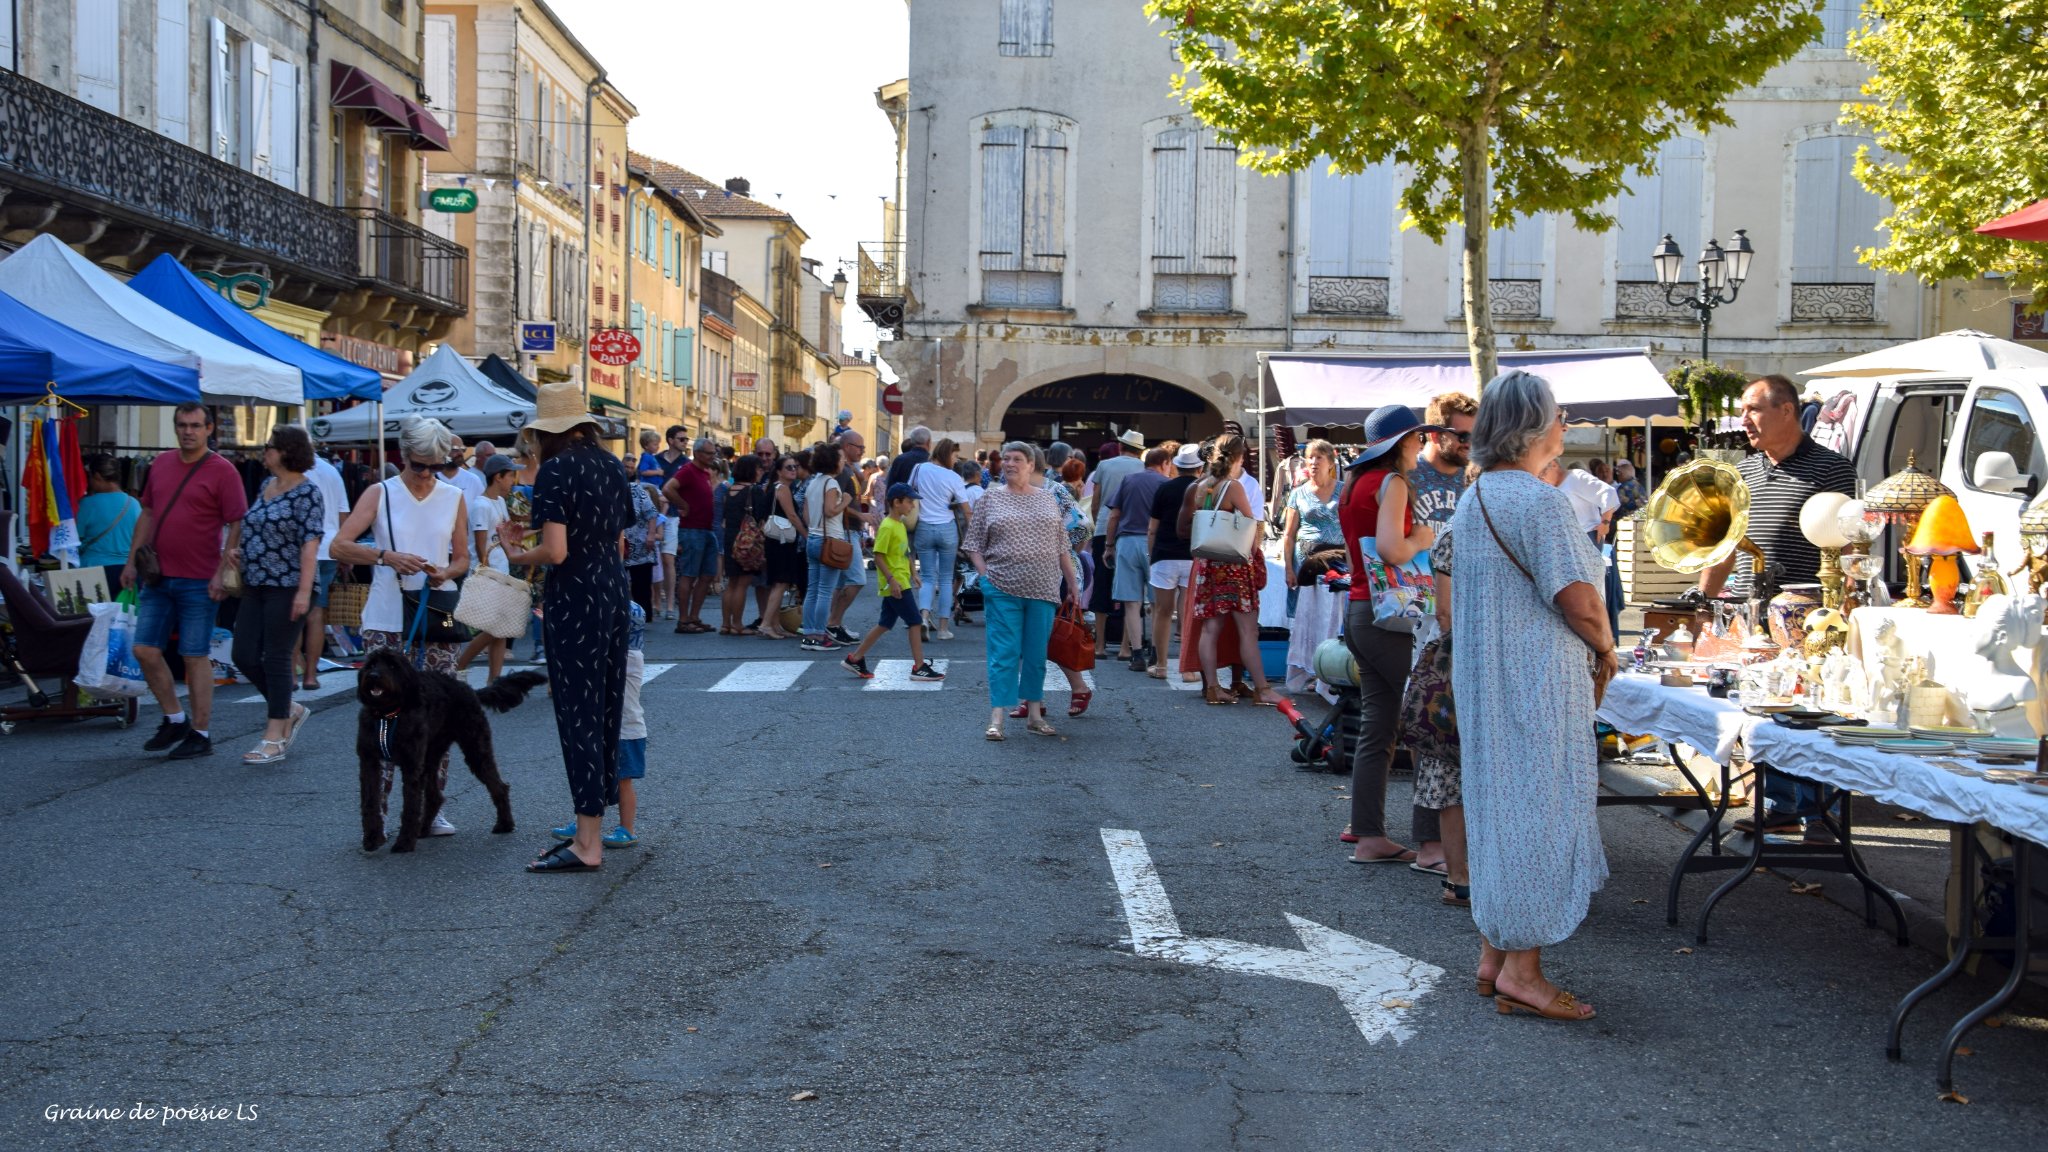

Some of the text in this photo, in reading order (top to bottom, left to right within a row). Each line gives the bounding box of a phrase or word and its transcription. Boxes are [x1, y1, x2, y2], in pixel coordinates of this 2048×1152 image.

[524, 329, 551, 339] LCL
[597, 332, 632, 345] CAFE
[591, 344, 638, 353] DE LA
[600, 353, 629, 365] PAIX
[1022, 385, 1078, 400] eure
[1092, 385, 1112, 400] et
[1413, 490, 1456, 520] UPER
